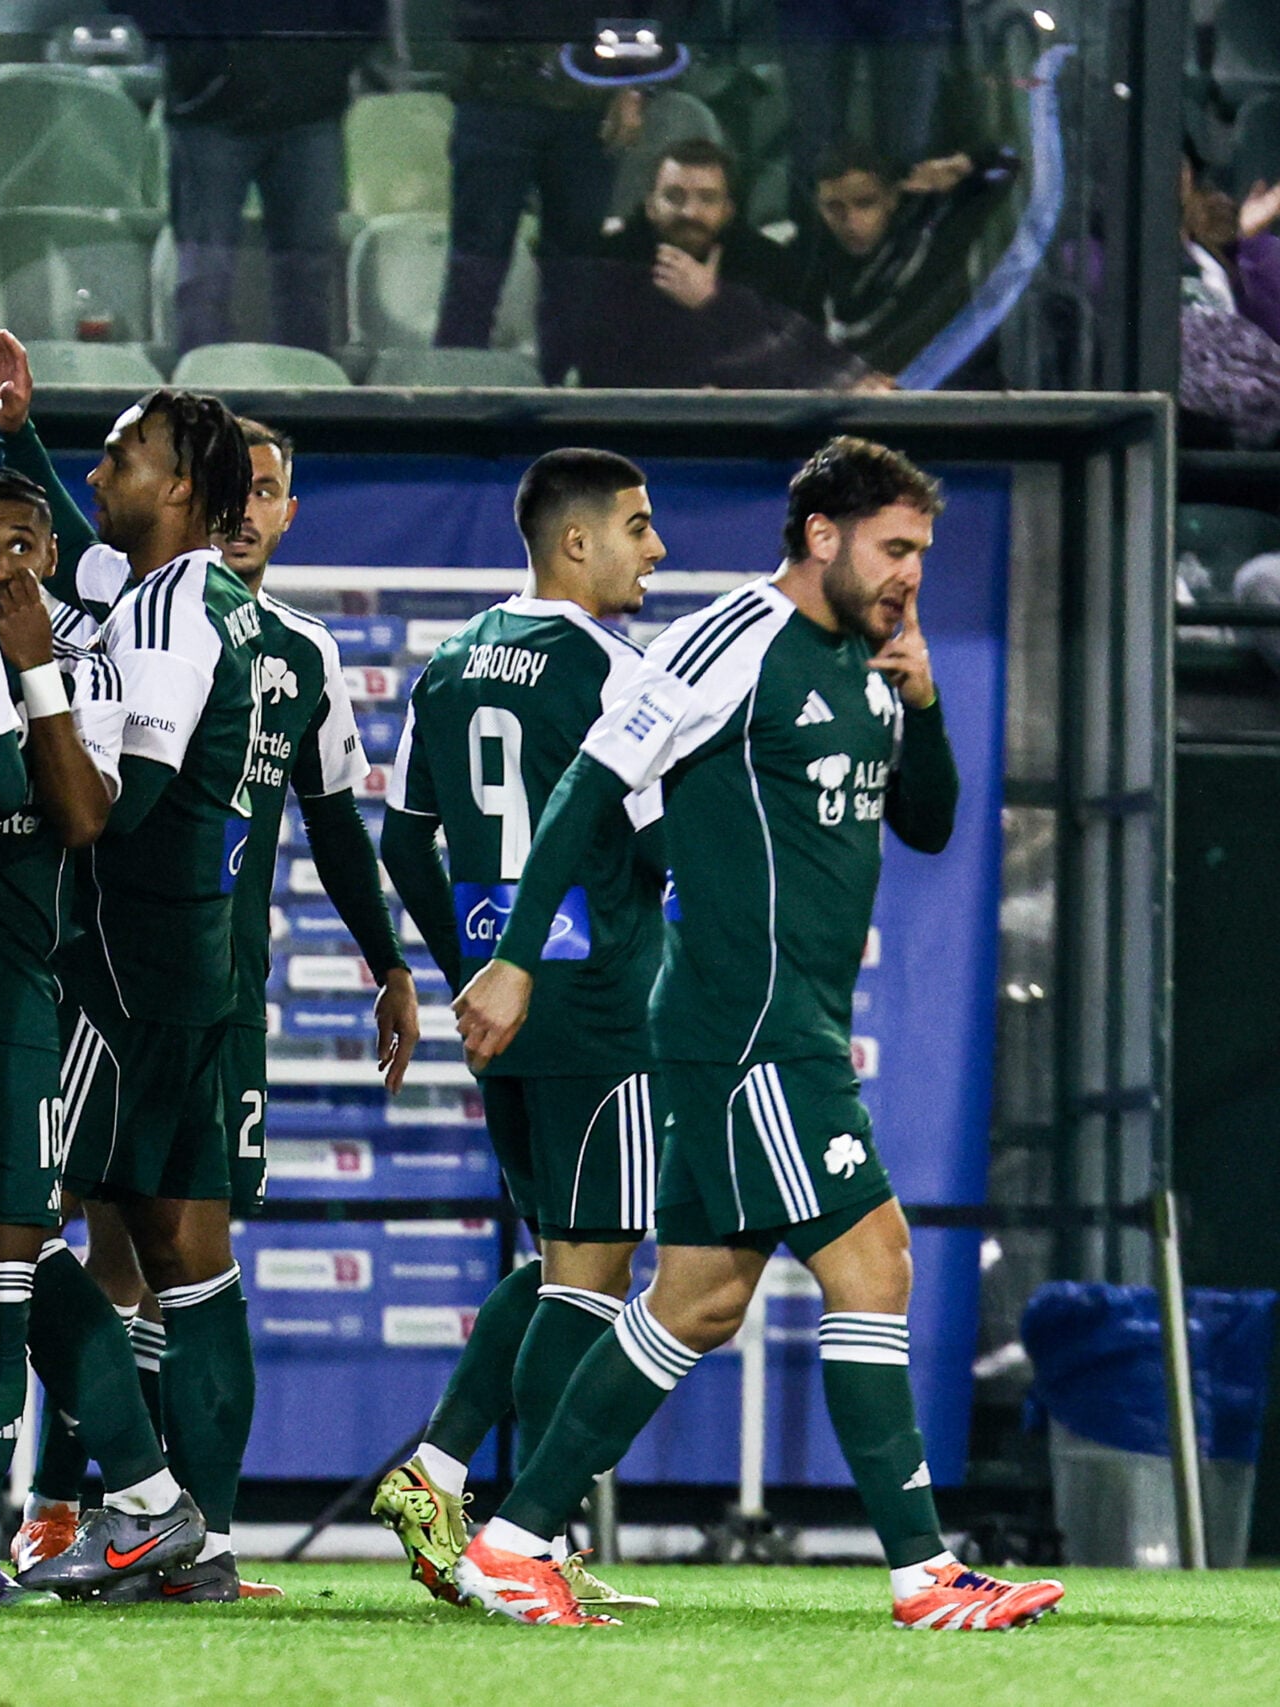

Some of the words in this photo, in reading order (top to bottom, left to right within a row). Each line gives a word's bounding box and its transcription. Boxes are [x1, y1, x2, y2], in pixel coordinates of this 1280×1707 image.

[462, 644, 549, 687] ZAROURY
[468, 706, 532, 880] 9
[38, 1097, 64, 1169] 10
[238, 1089, 268, 1158] 2
